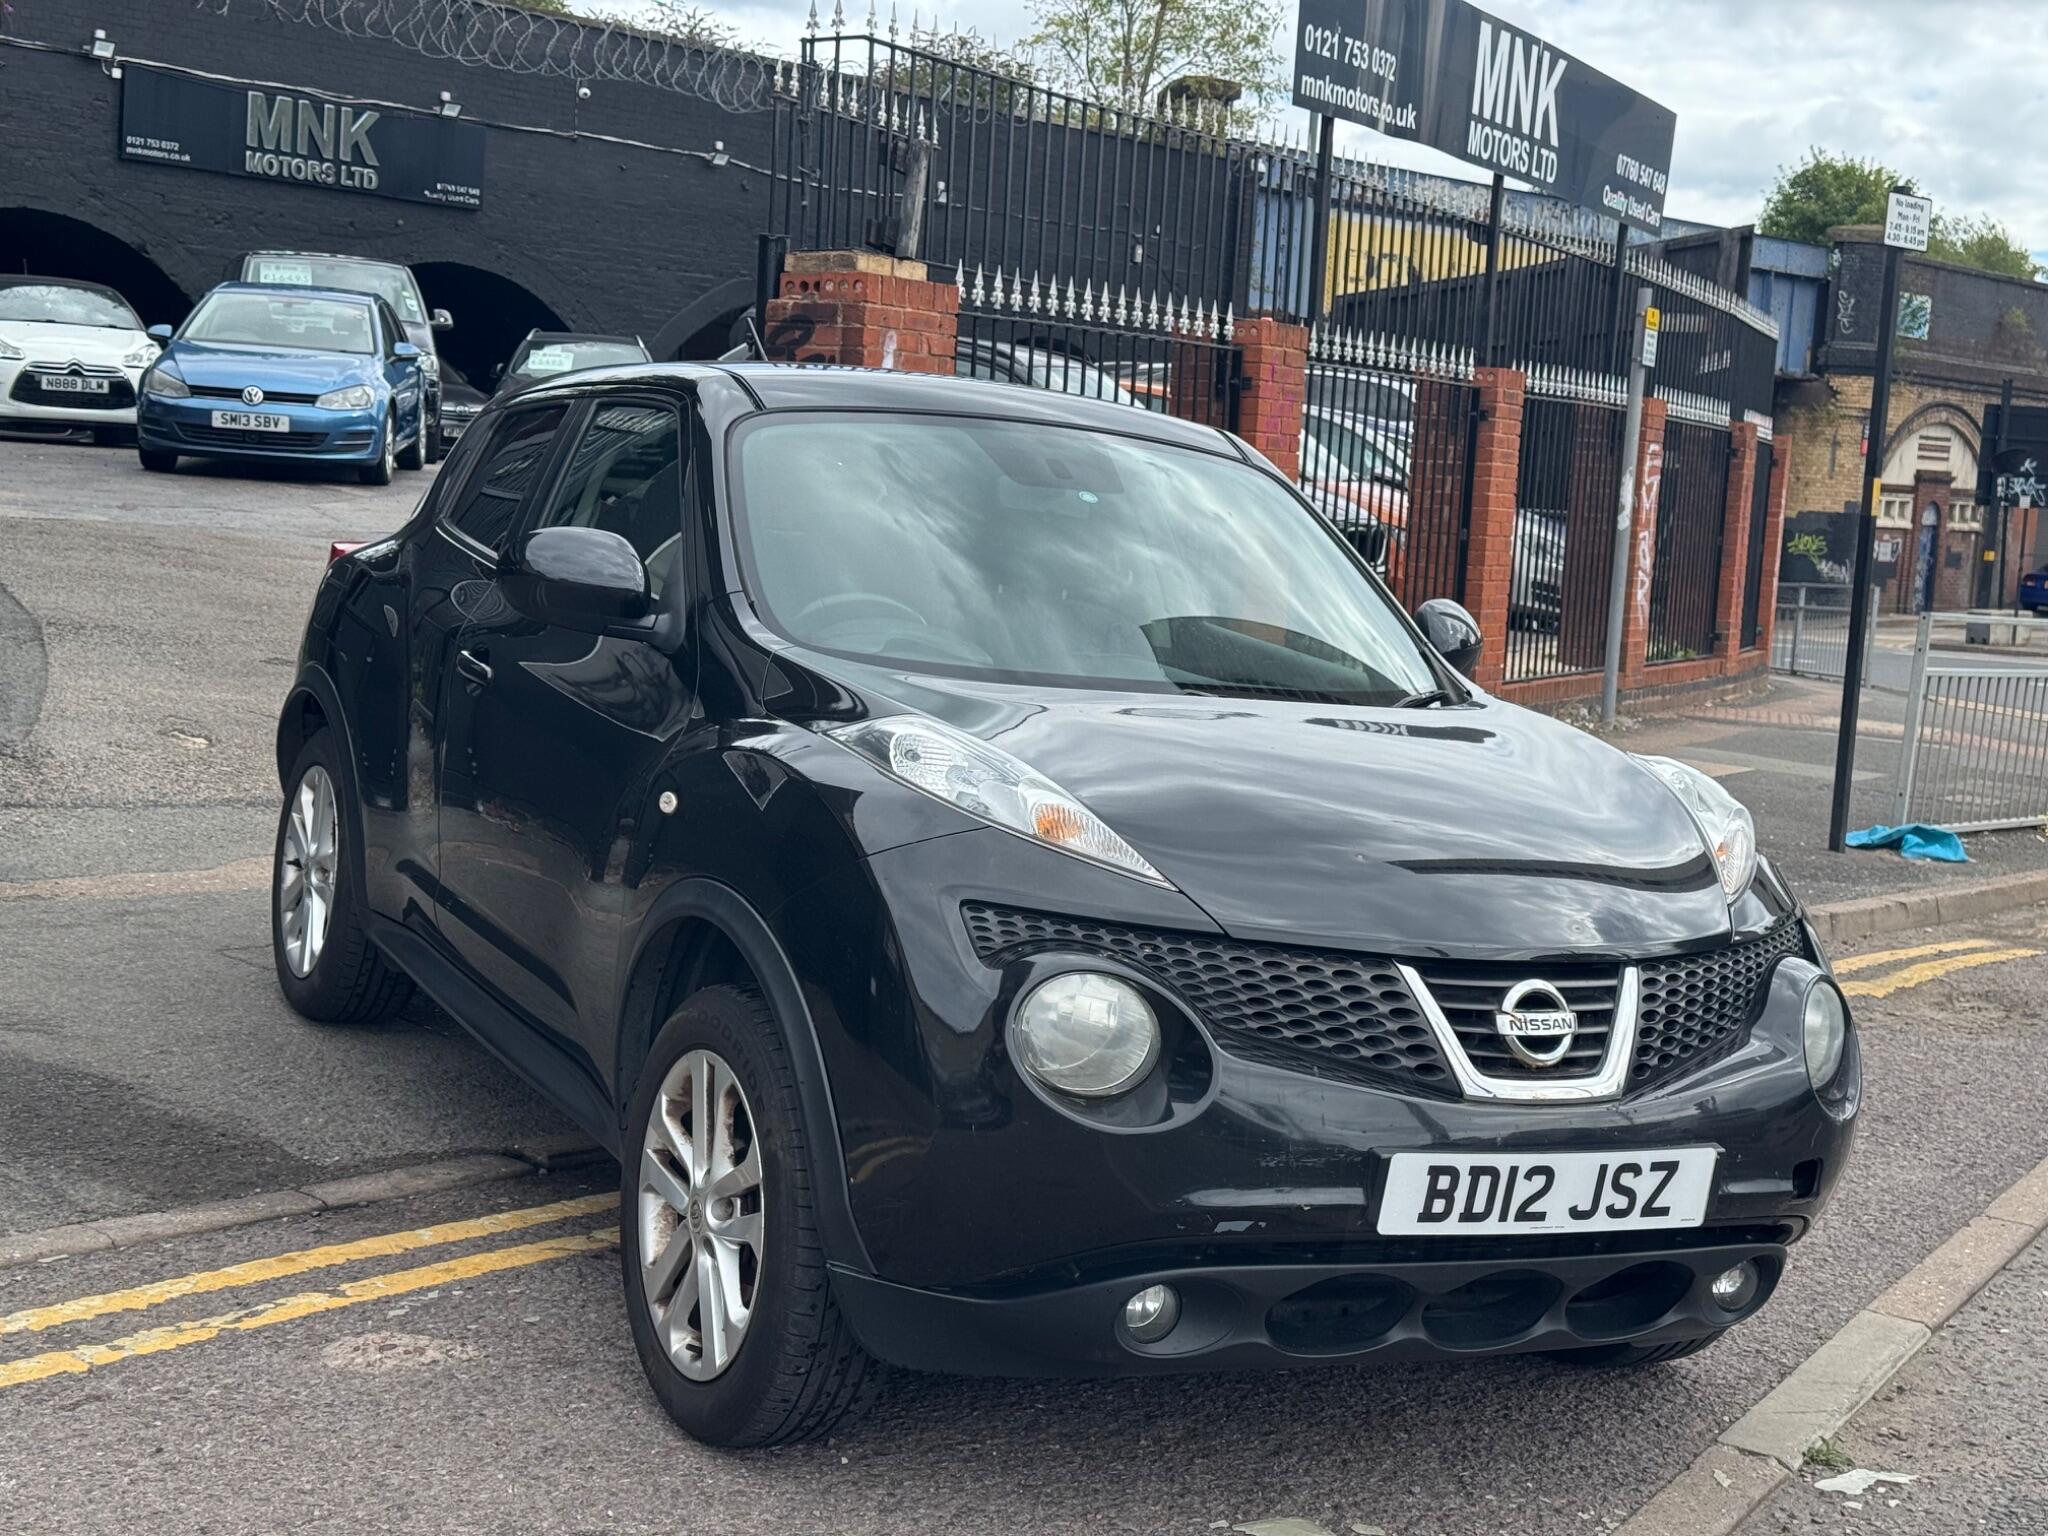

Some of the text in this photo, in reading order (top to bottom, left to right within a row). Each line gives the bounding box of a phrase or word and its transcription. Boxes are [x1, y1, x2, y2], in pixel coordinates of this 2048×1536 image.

[1304, 23, 1397, 82] 0121 753 0372
[1300, 74, 1417, 130] mnkmotors.co.uk
[1471, 20, 1568, 148] MNK
[126, 135, 145, 146] 0121
[146, 138, 160, 148] 753
[246, 90, 380, 166] MNK
[245, 150, 379, 190] MOTORS LTD
[1467, 119, 1558, 184] MOTORS LTD
[1616, 153, 1640, 183] 07760
[1639, 164, 1654, 188] 547
[1602, 184, 1661, 228] Quality Used Cars
[1895, 197, 1924, 213] No loading
[46, 377, 78, 389] N888
[220, 412, 280, 429] SM13 SBV
[1508, 1016, 1572, 1032] NISSAN
[1416, 1160, 1680, 1223] BD12 JSZ
